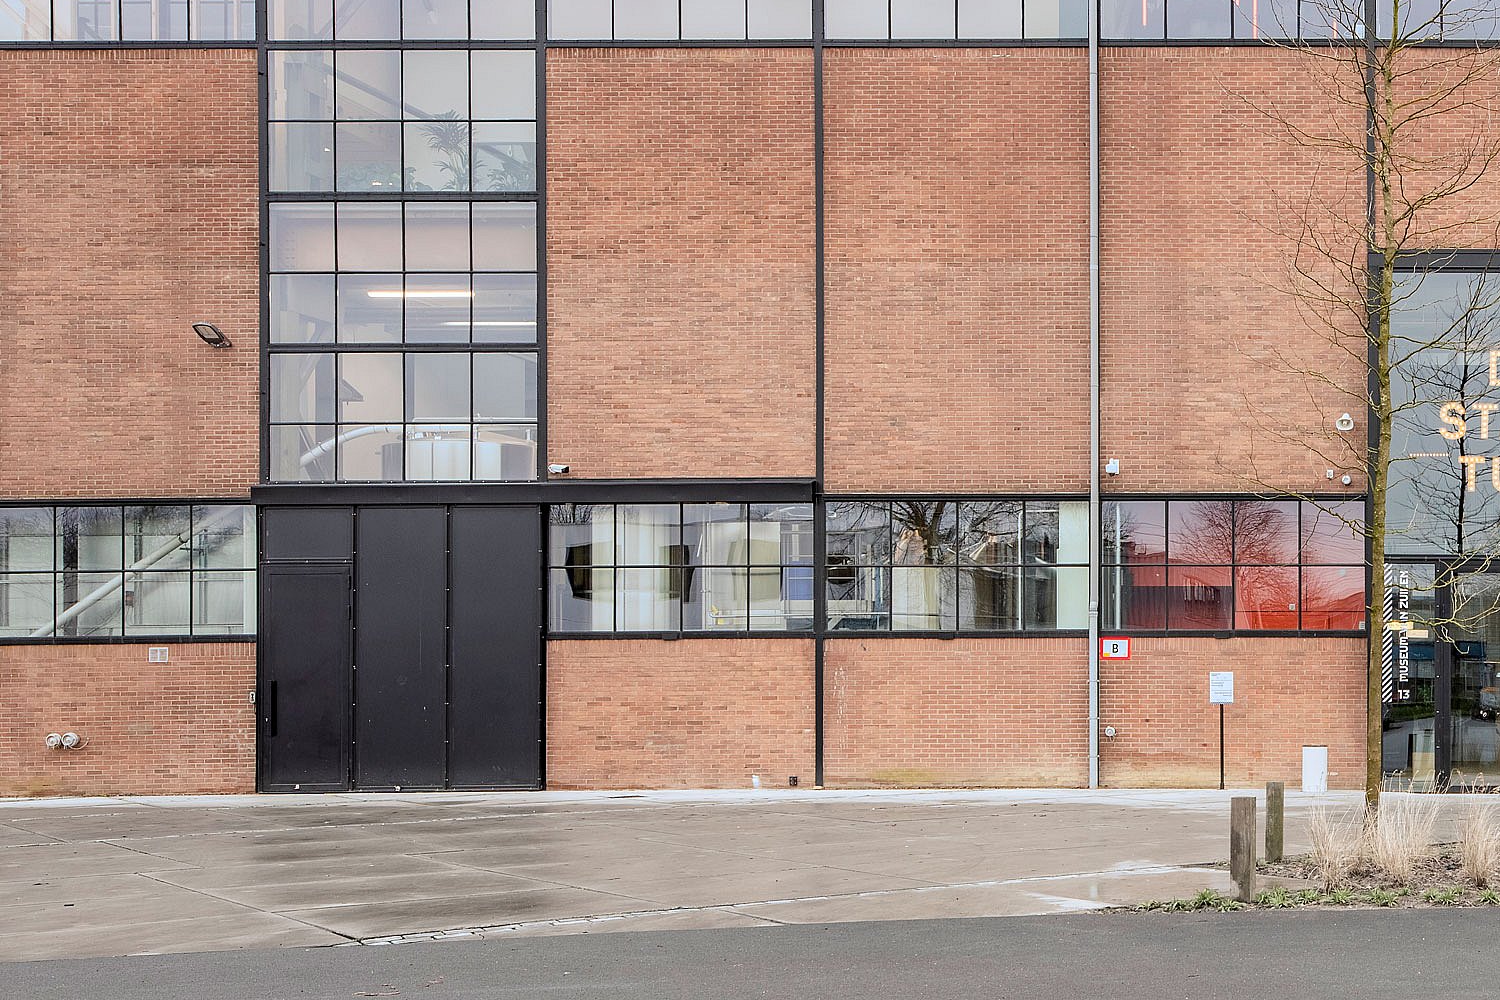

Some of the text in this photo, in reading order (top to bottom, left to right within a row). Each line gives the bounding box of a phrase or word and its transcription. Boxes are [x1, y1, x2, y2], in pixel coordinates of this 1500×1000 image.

[1112, 643, 1119, 653] B
[1399, 637, 1409, 682] MUSEUM
[1398, 690, 1410, 699] 13
